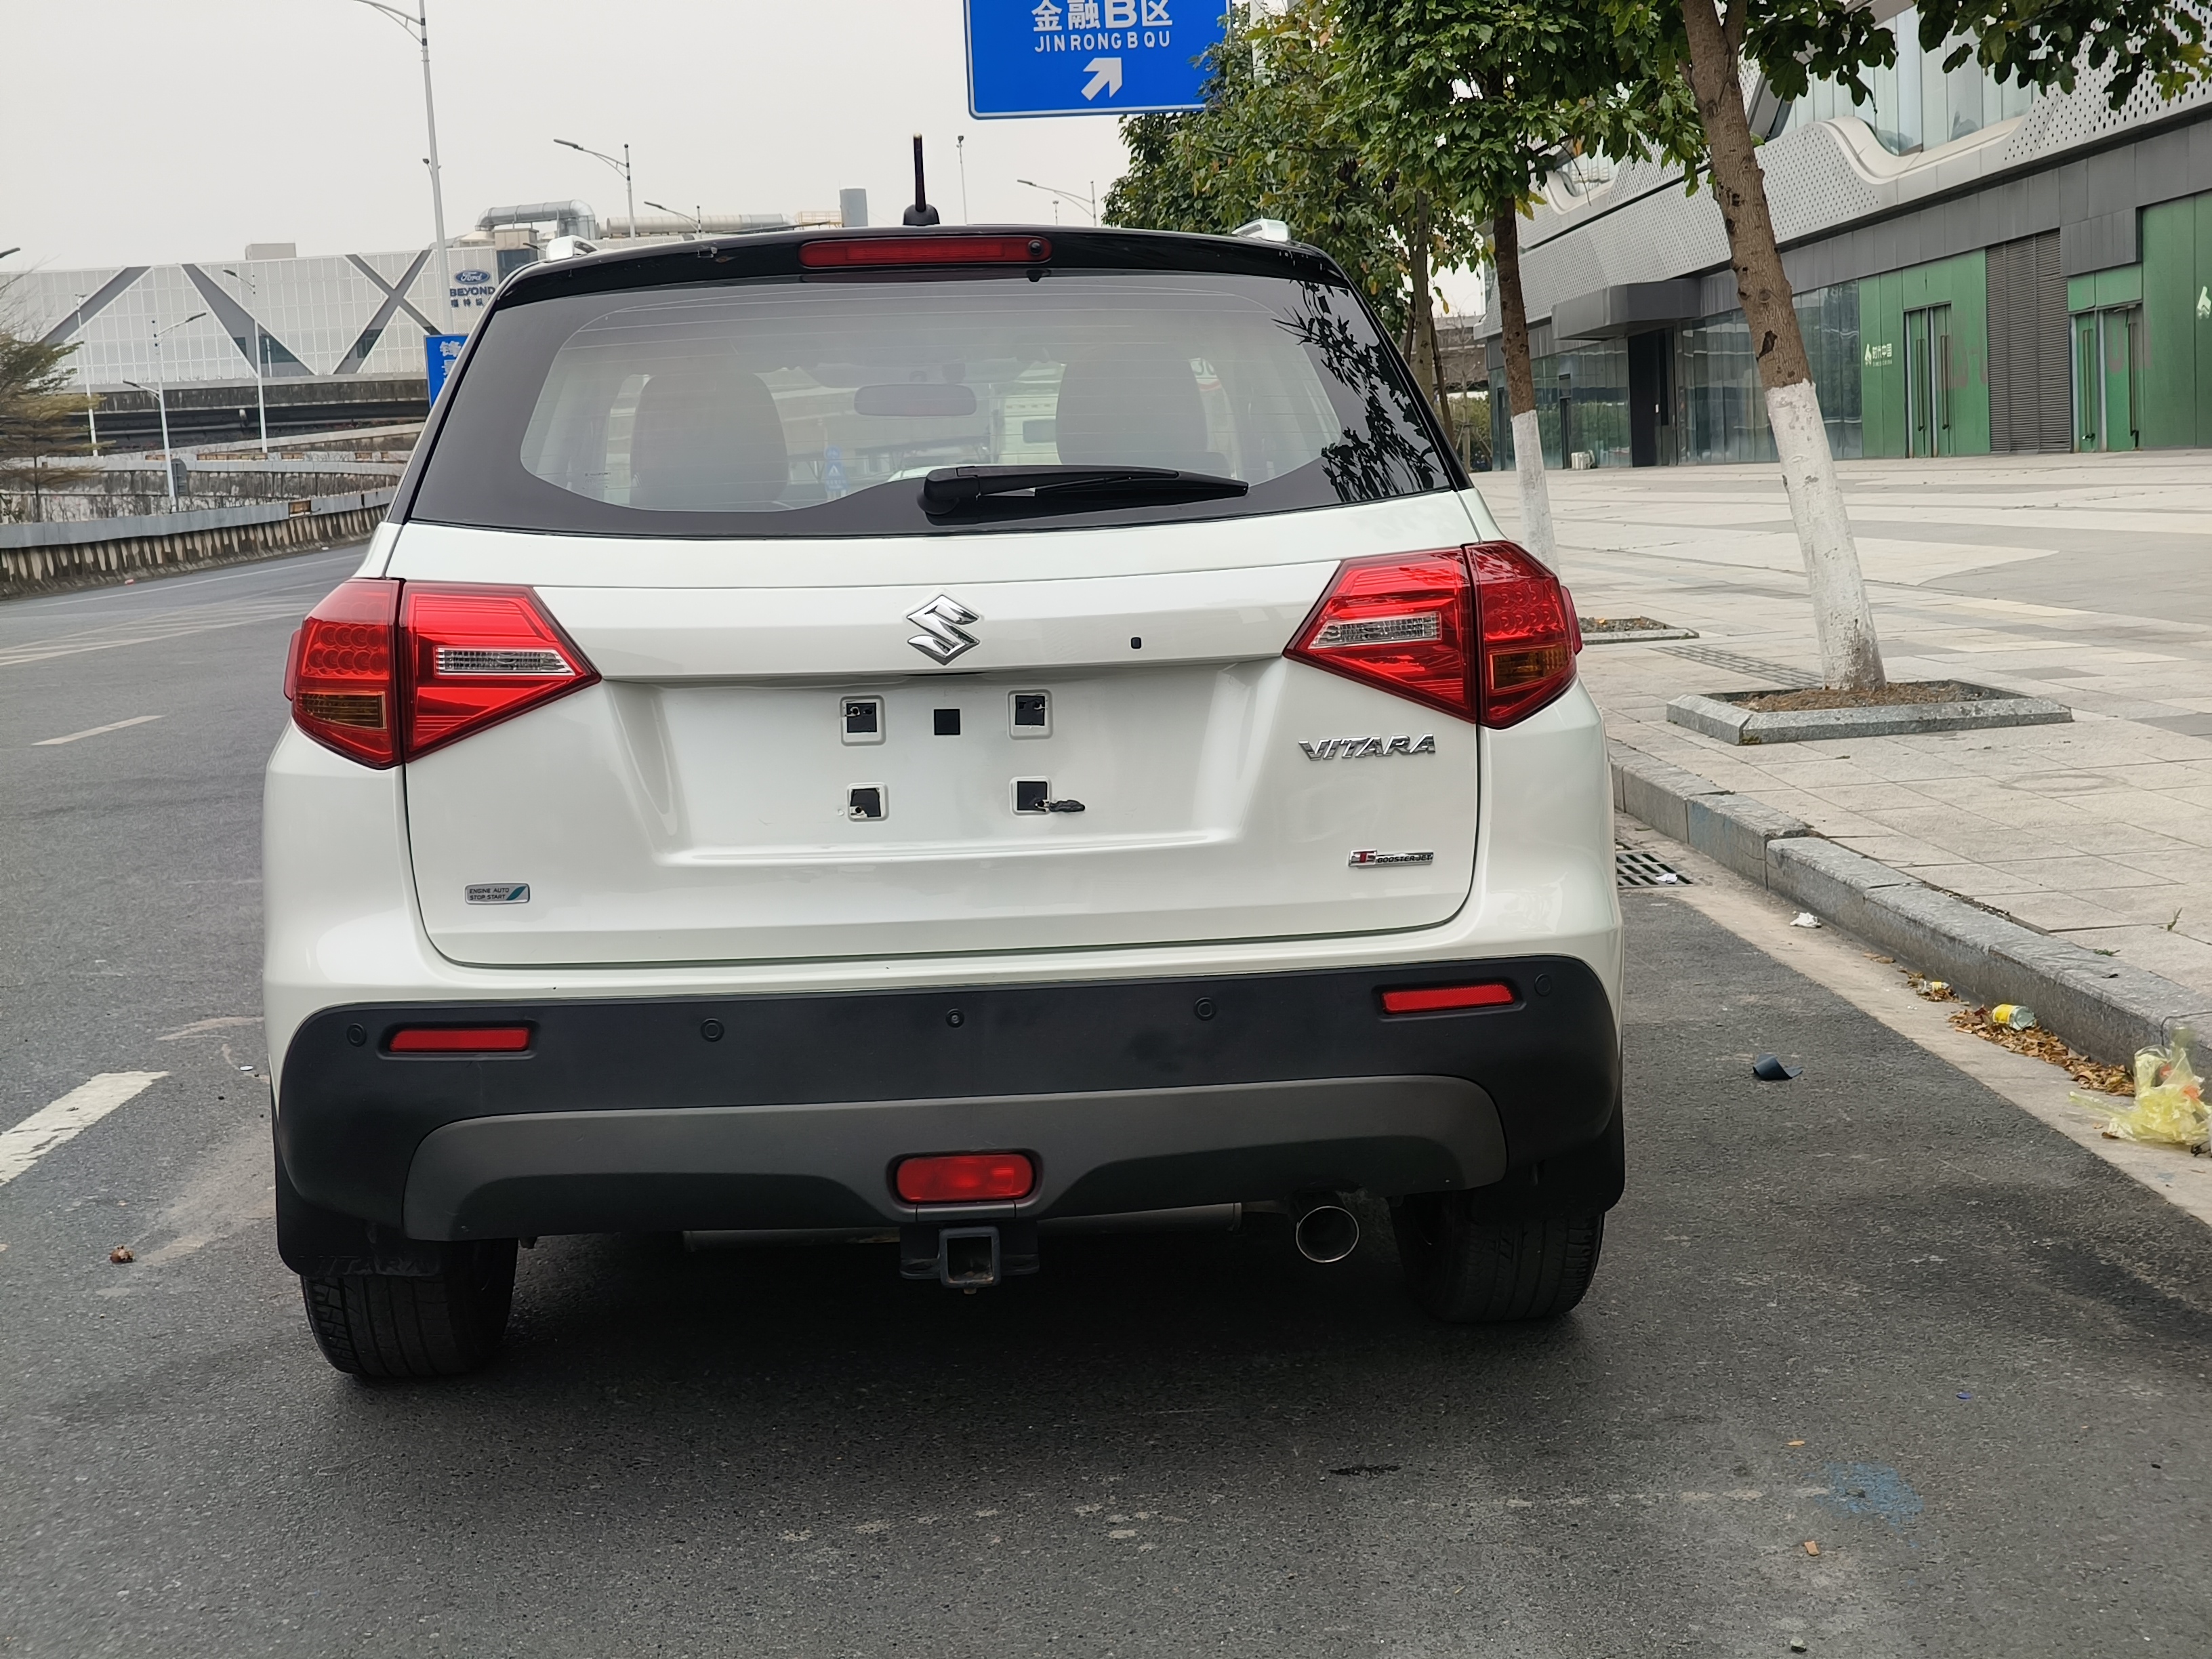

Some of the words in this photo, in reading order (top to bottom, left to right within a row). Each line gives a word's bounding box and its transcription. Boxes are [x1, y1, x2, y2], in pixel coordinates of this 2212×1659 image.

[1031, 0, 1173, 32] 金融B区
[449, 286, 496, 297] BEYOND
[1872, 343, 1892, 359] 时代中国
[1298, 733, 1436, 761] VITARA
